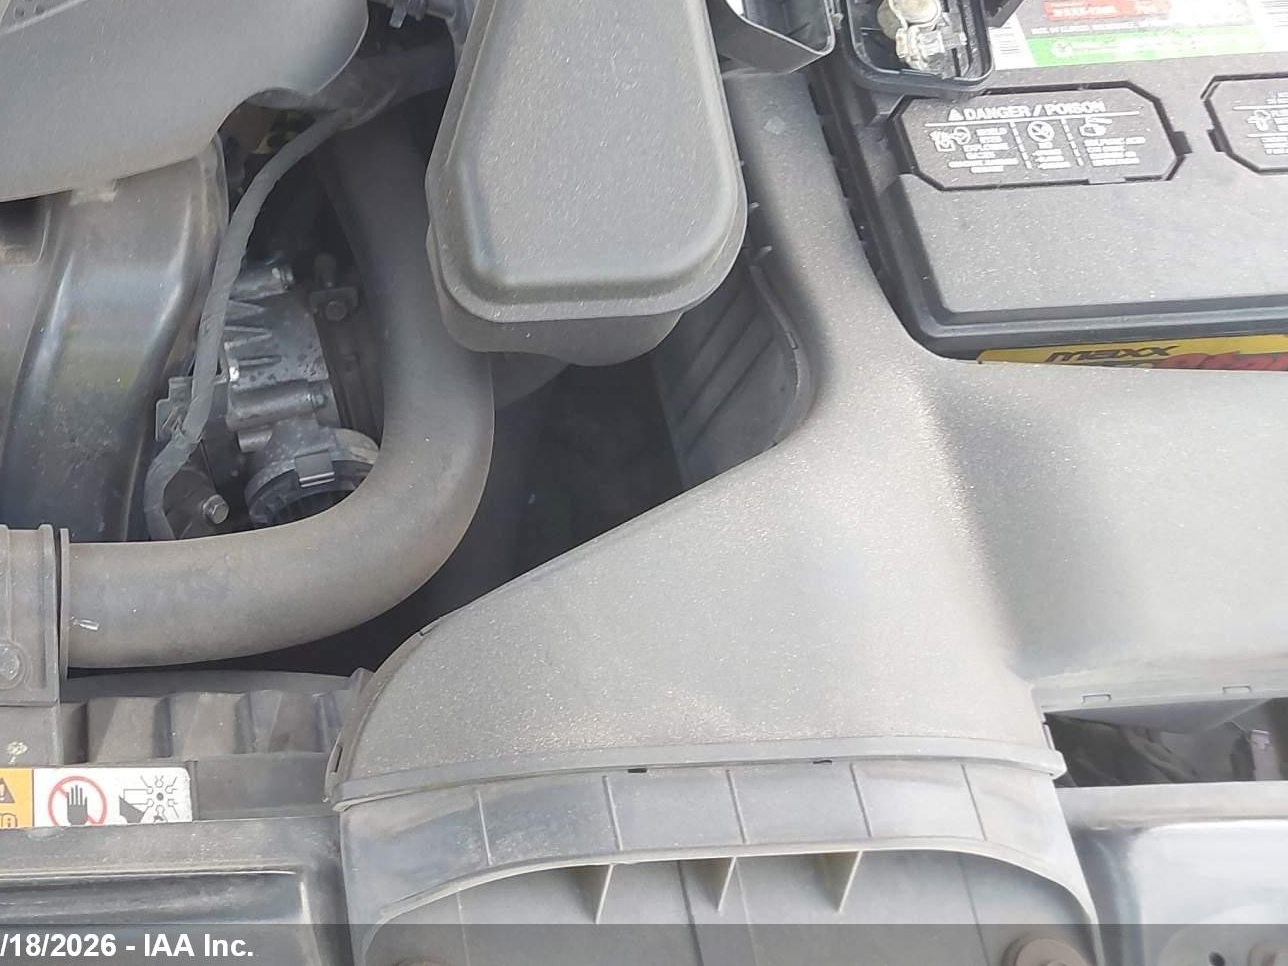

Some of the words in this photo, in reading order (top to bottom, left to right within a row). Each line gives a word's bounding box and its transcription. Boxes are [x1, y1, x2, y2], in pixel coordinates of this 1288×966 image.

[963, 105, 1031, 120] DANGER
[1044, 100, 1106, 115] POISON
[1045, 345, 1179, 363] maxx
